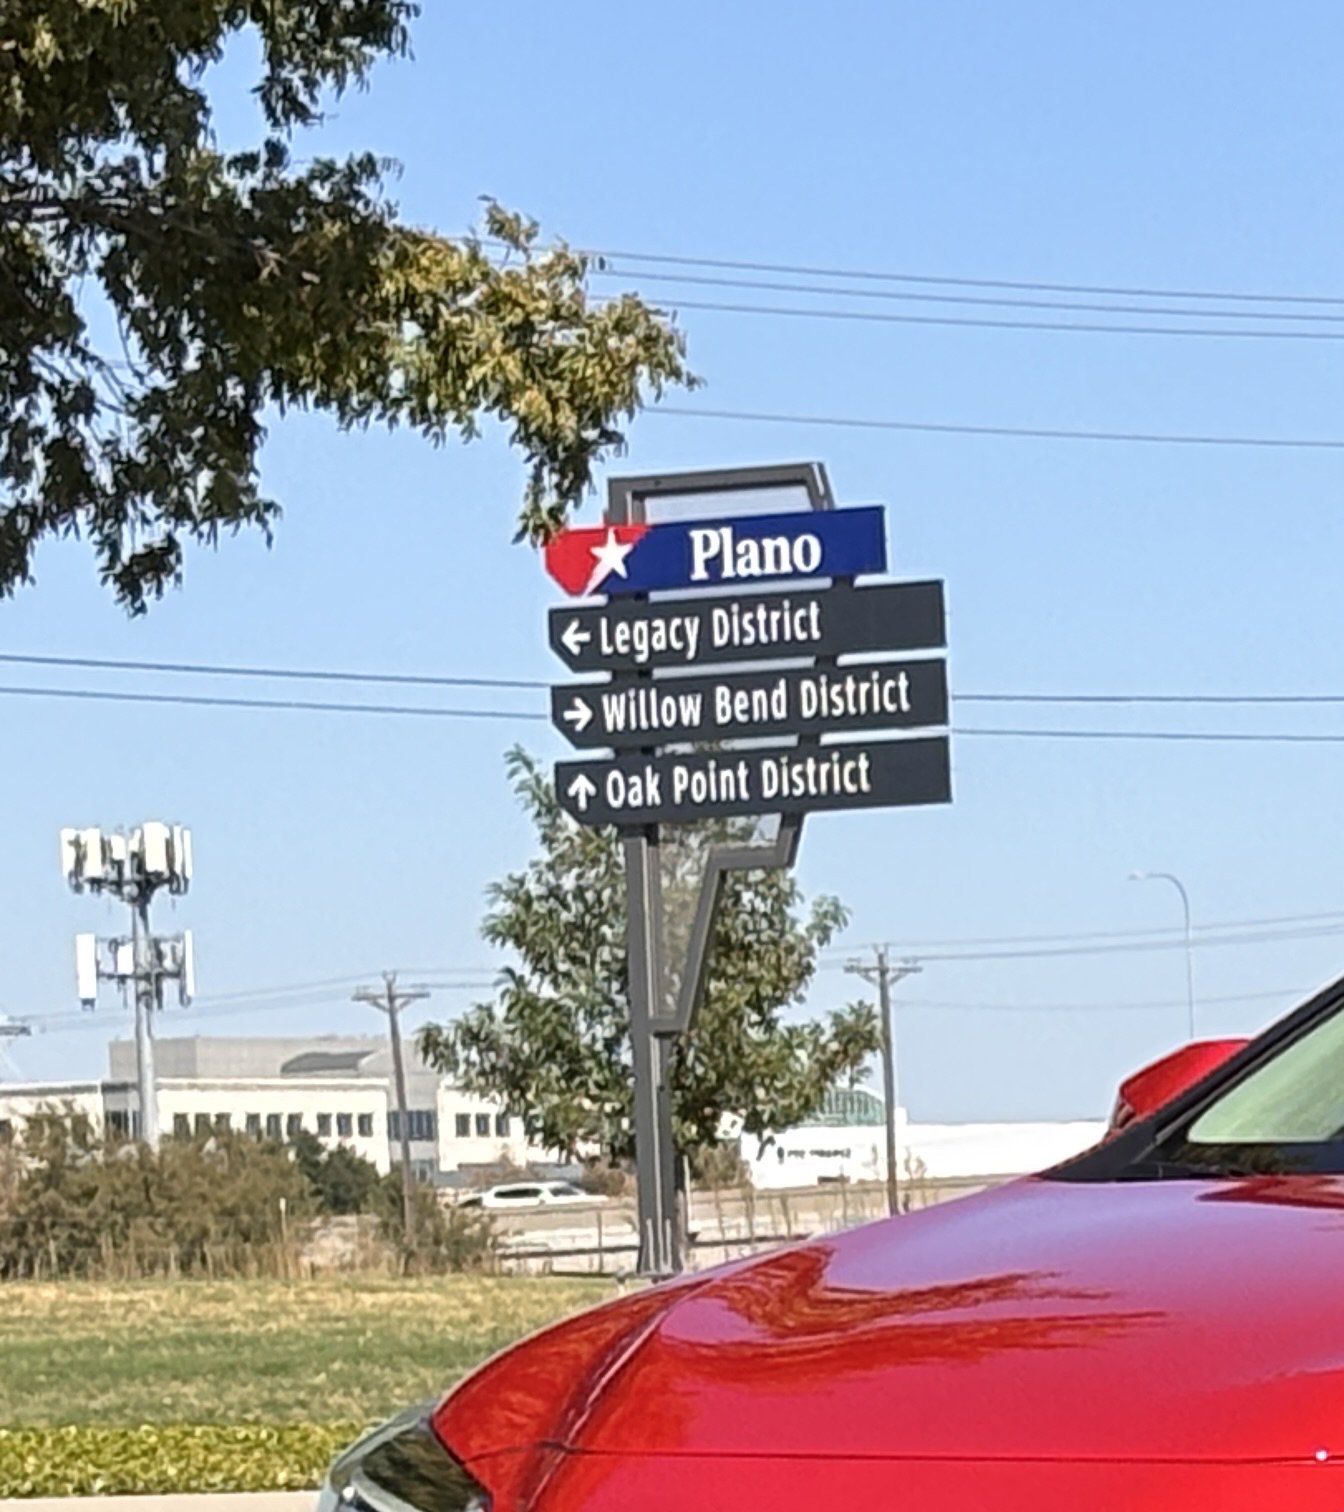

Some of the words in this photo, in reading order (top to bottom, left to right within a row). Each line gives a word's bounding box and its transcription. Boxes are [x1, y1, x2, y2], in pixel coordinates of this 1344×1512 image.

[688, 527, 822, 581] Plano
[600, 616, 700, 662] Legacy
[711, 600, 821, 648] District
[602, 688, 702, 732] Willow
[715, 678, 788, 725] Bend
[801, 671, 911, 717] District
[605, 764, 661, 808] Oak
[673, 760, 750, 804] Point
[762, 751, 871, 799] District
